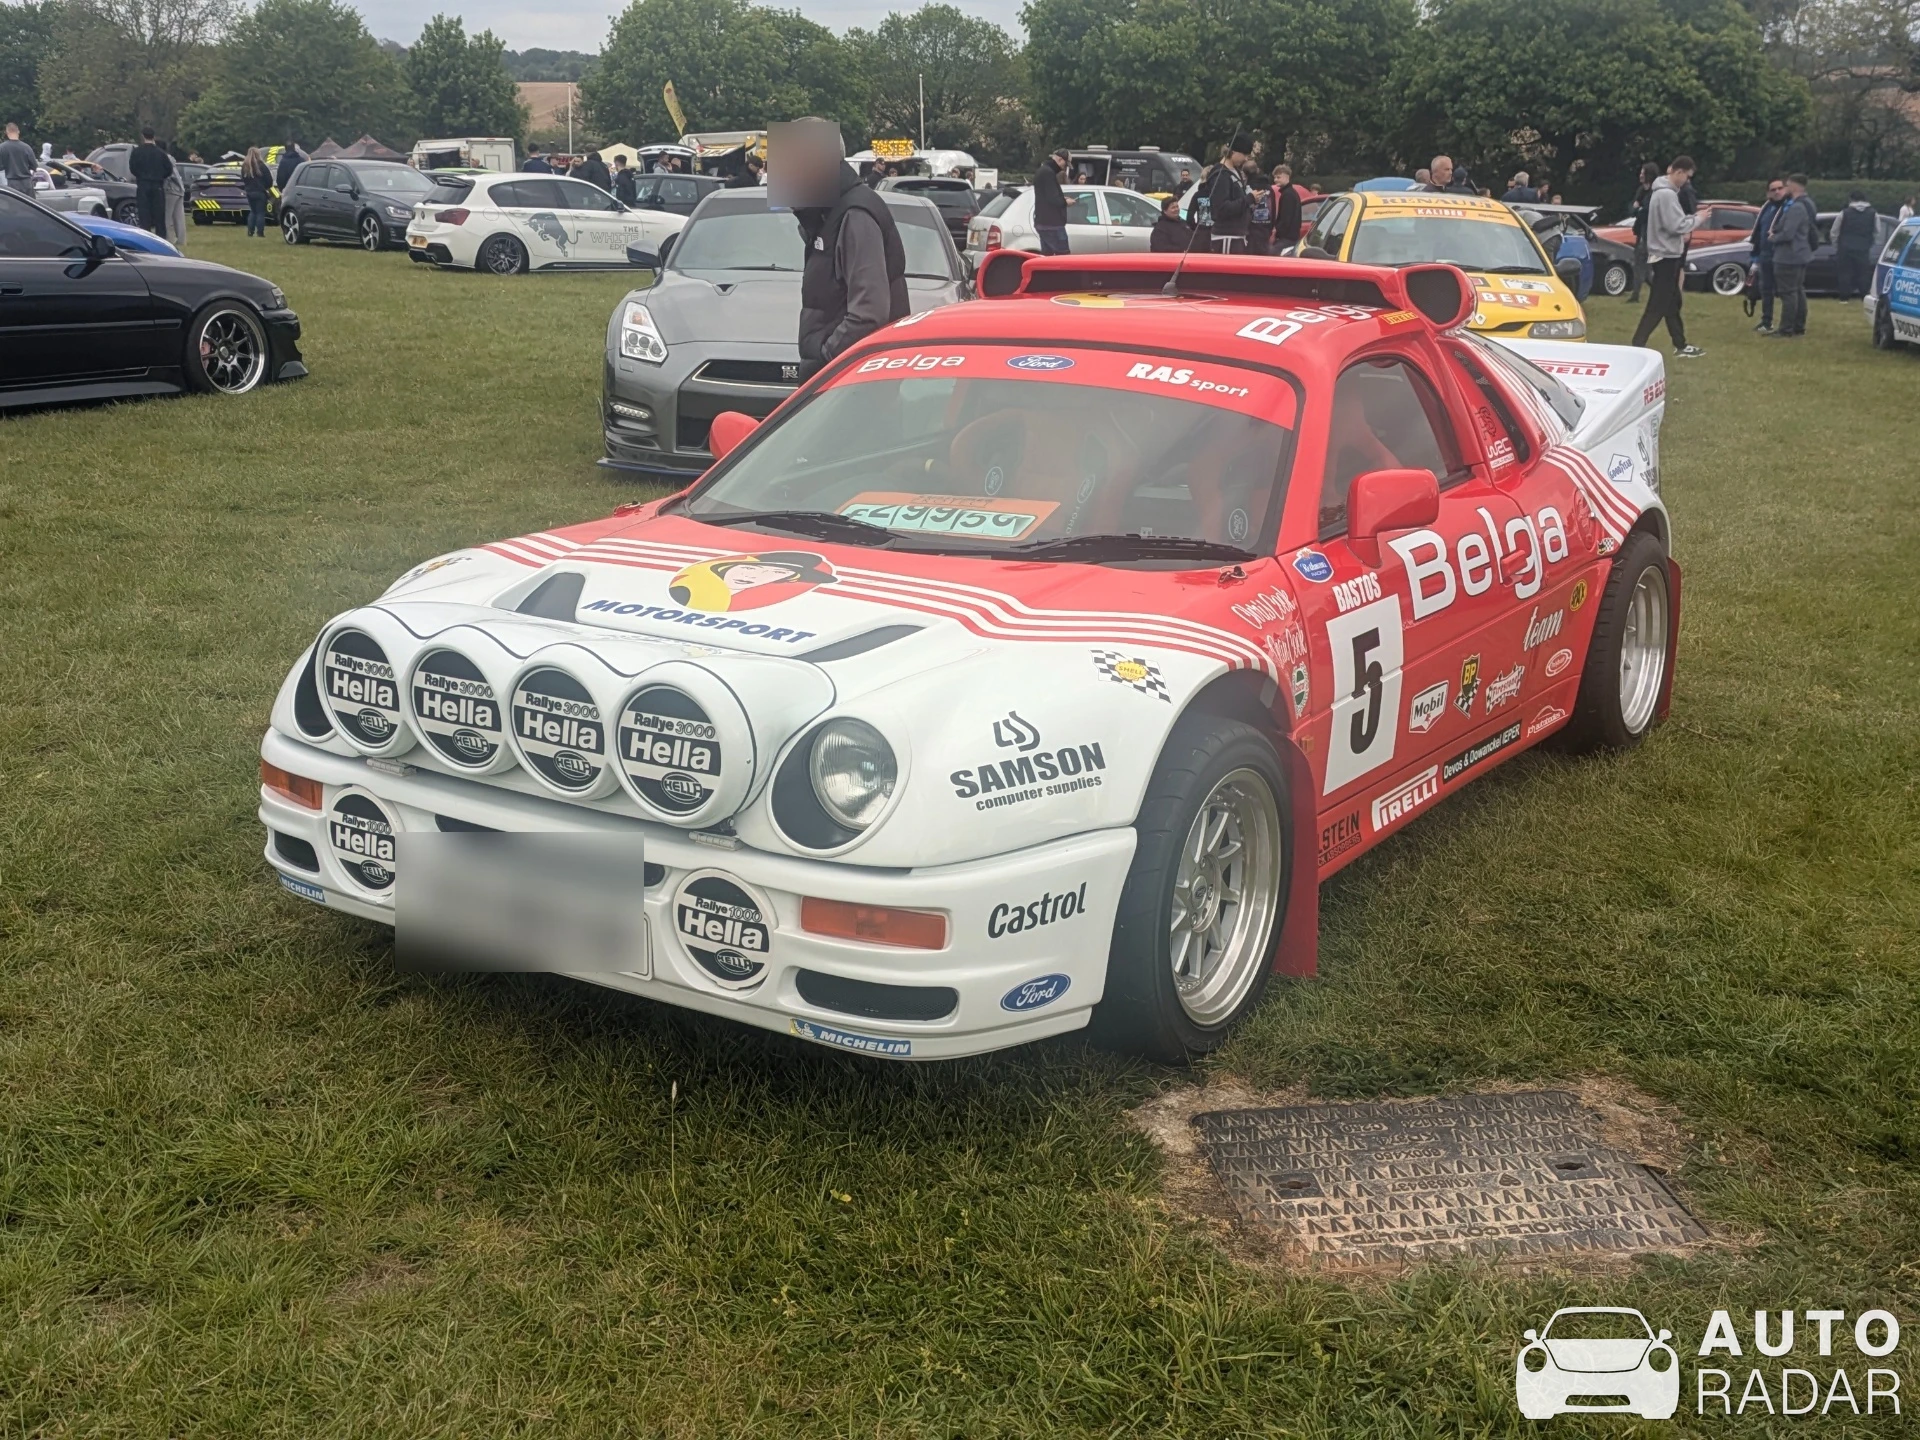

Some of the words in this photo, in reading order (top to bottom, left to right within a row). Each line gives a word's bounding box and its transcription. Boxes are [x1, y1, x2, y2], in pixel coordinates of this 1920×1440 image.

[1417, 208, 1464, 217] KALIBER
[590, 231, 639, 244] WHITE
[1895, 279, 1920, 294] OMEG
[1235, 303, 1383, 346] Belga
[857, 353, 965, 374] Belga
[1017, 356, 1060, 369] Ford
[1127, 362, 1195, 386] RAS
[1190, 379, 1249, 398] sport
[1486, 437, 1512, 458] WRC
[1609, 459, 1633, 479] GOODYEAR
[1388, 506, 1568, 621] Belga
[1332, 572, 1382, 613] BASTOS
[583, 599, 818, 645] MOTORSPORT
[1523, 606, 1563, 652] team
[335, 654, 364, 672] Rallye
[364, 662, 395, 679] 3000
[1464, 662, 1477, 685] BP
[332, 671, 393, 707] Hella
[424, 674, 458, 691] Rallye
[459, 682, 494, 698] 3000
[1350, 627, 1383, 754] 5
[423, 691, 492, 728] Hella
[525, 693, 562, 711] Rallye
[562, 702, 599, 720] 3000
[1414, 692, 1443, 719] Mobil
[359, 714, 390, 732] HELLA
[523, 711, 597, 749] Hella
[634, 713, 674, 732] Rallye
[675, 721, 715, 740] 3000
[454, 735, 490, 753] HELLA
[630, 732, 712, 770] Hella
[556, 758, 592, 774] HELLA
[950, 742, 1106, 798] SAMSON
[1464, 753, 1469, 767] &
[664, 780, 703, 798] HELLA
[976, 787, 1043, 811] computer
[1047, 776, 1102, 795] supplies
[1371, 765, 1439, 832] PIRELLI
[342, 814, 366, 828] Rallye
[367, 821, 392, 834] 1000
[1319, 810, 1359, 853] STEIN
[335, 825, 393, 859] Hella
[362, 865, 389, 879] HELLA
[282, 878, 323, 900] MICHELIN
[695, 897, 728, 914] Rallye
[729, 906, 762, 923] 1000
[988, 881, 1087, 938] Castrol
[684, 909, 763, 949] Hella
[717, 955, 752, 971] HELLA
[1016, 979, 1058, 1006] Ford
[820, 1031, 909, 1054] MICHELIN
[1397, 1224, 1499, 1243] COVERS
[1506, 1216, 1619, 1236] MANHOLE
